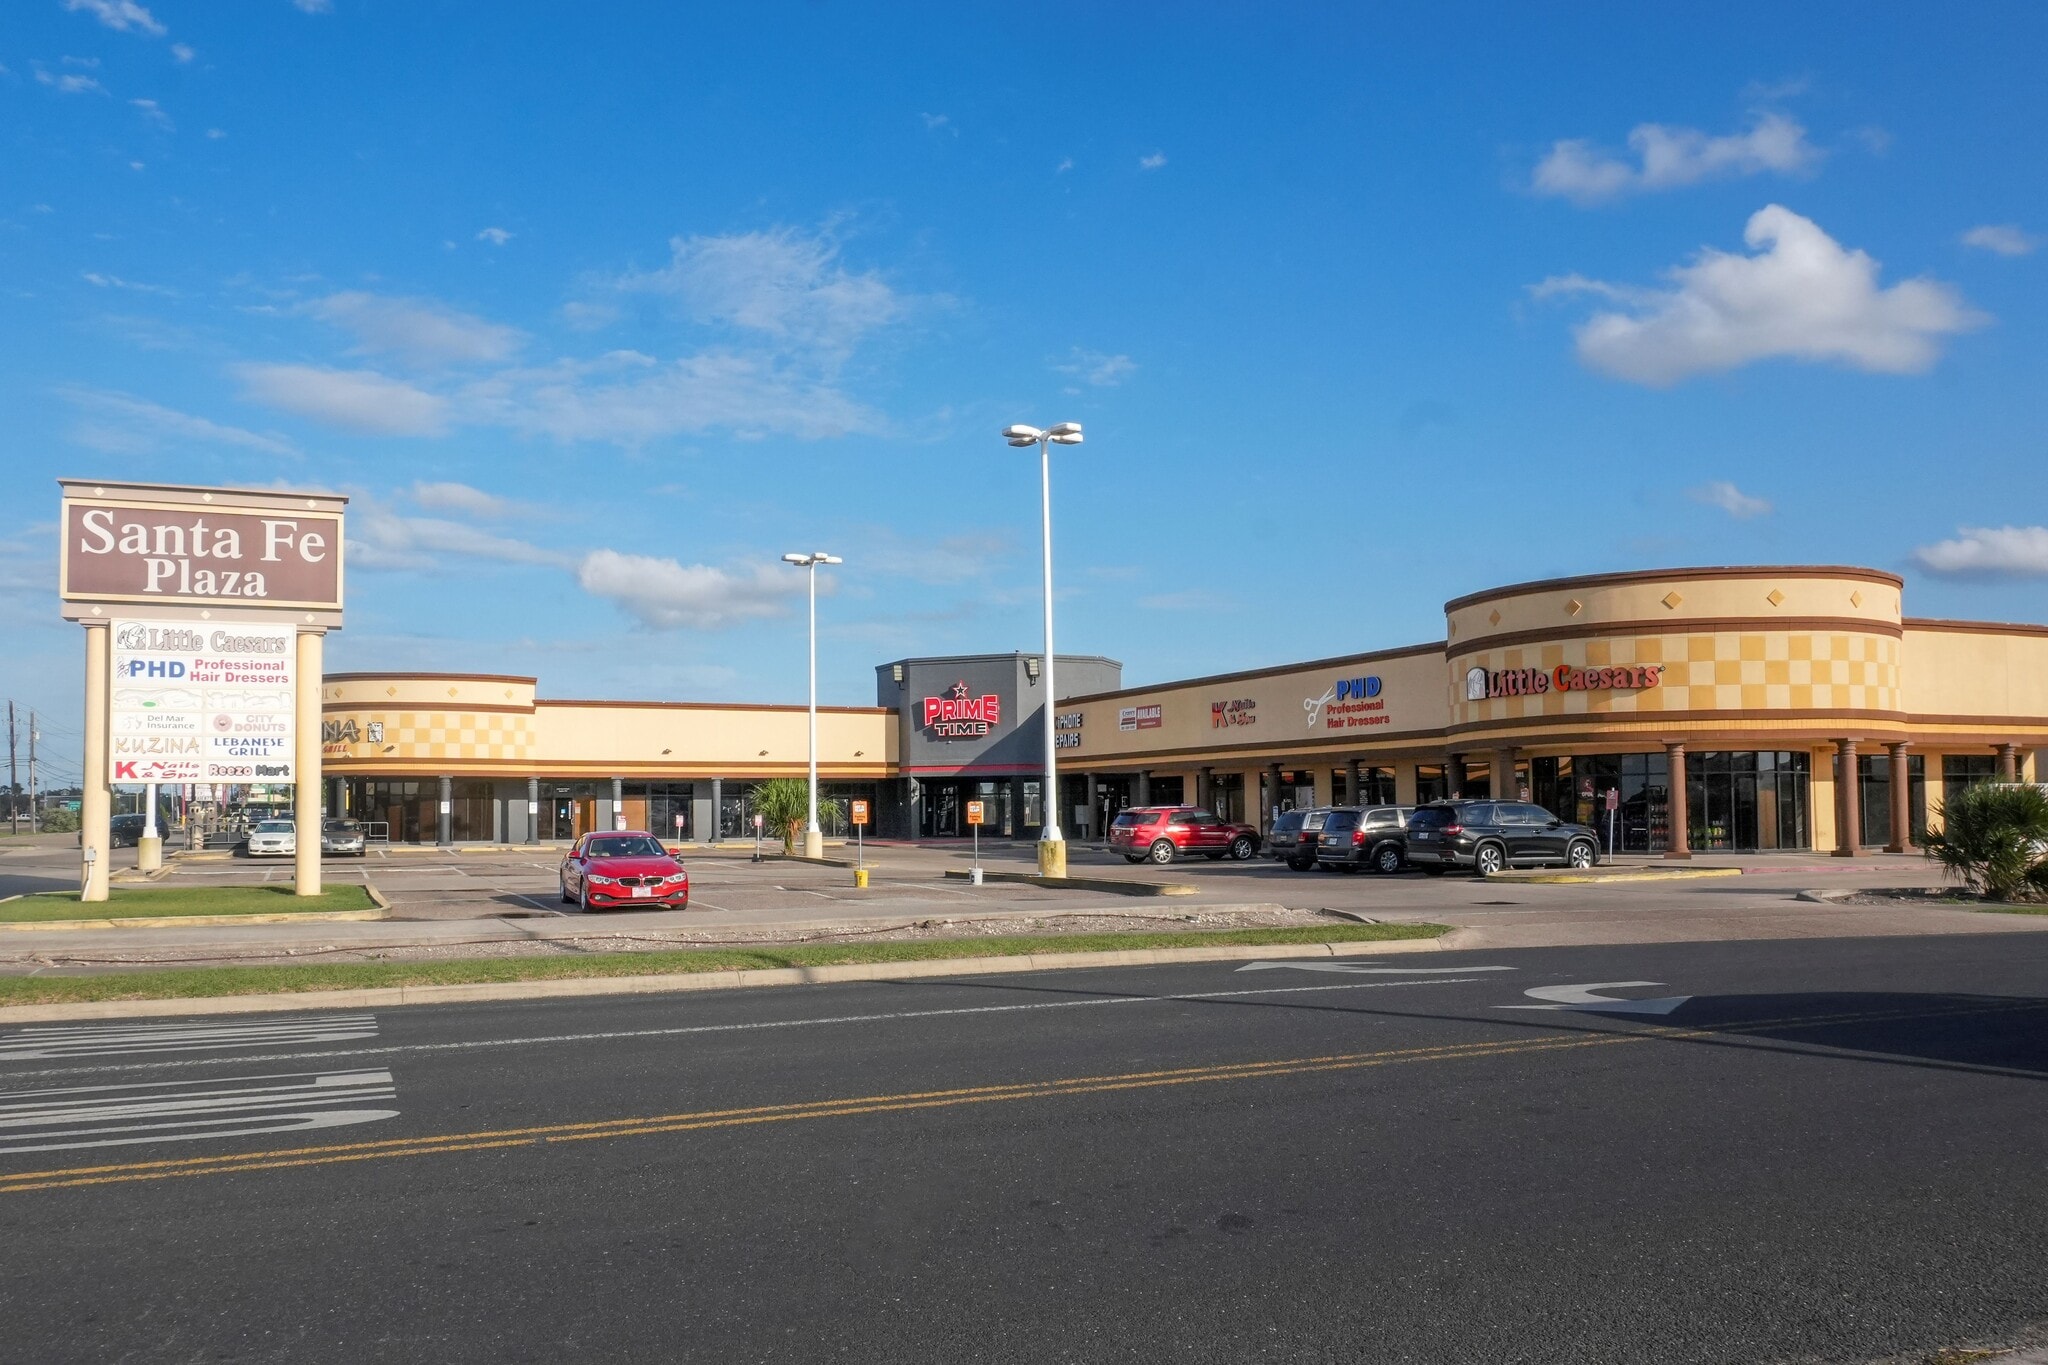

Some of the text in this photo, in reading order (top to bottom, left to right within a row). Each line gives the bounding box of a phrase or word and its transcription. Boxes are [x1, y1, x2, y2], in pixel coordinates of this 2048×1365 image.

[81, 510, 326, 563] Santa Fe
[143, 559, 268, 597] Plaza
[148, 628, 286, 654] Little Caesars
[129, 660, 185, 678] PHD
[194, 658, 285, 671] Professional
[190, 671, 289, 684] Hair Dressers
[1489, 664, 1659, 698] Little Caesars
[1336, 676, 1382, 701] PHD
[924, 694, 1000, 726] PRIME
[1138, 707, 1161, 719] AVAILABLE
[1212, 699, 1255, 728] K Nails
[1326, 698, 1384, 717] Professional
[246, 715, 274, 723] CITY
[1327, 713, 1390, 729] Hair Dressers
[234, 723, 286, 732] DONUTS
[934, 722, 989, 736] TIME
[115, 737, 200, 754] KUZINA
[214, 738, 284, 747] LEBANESE
[1055, 732, 1080, 748] EPAIRS
[229, 747, 271, 756] GRILL
[115, 761, 200, 779] K Nails
[142, 770, 199, 779] & Spa
[208, 764, 289, 777] Reezo Mart
